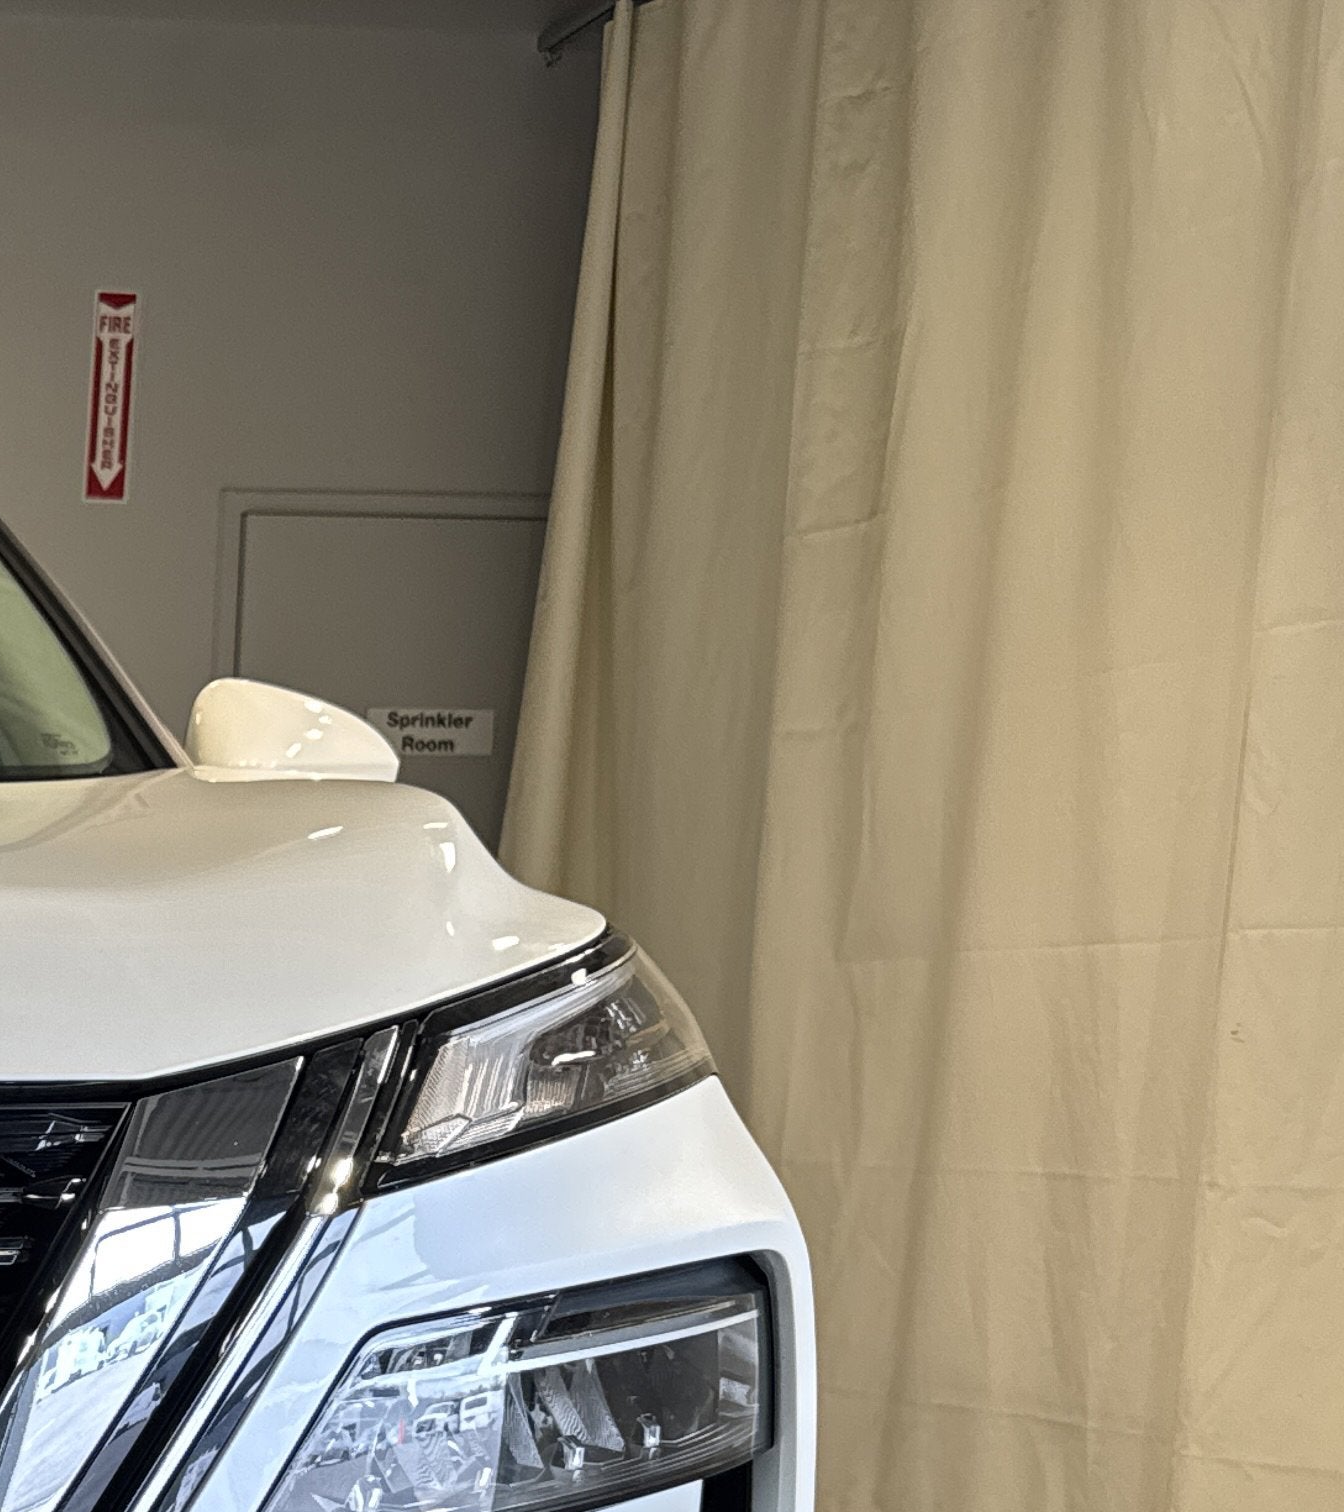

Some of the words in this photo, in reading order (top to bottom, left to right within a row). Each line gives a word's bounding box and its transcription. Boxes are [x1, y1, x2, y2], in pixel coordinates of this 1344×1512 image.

[99, 316, 132, 334] FIRE
[101, 339, 120, 469] EXTINGUISHER
[386, 711, 473, 730] Sprinkler
[401, 736, 454, 753] Room
